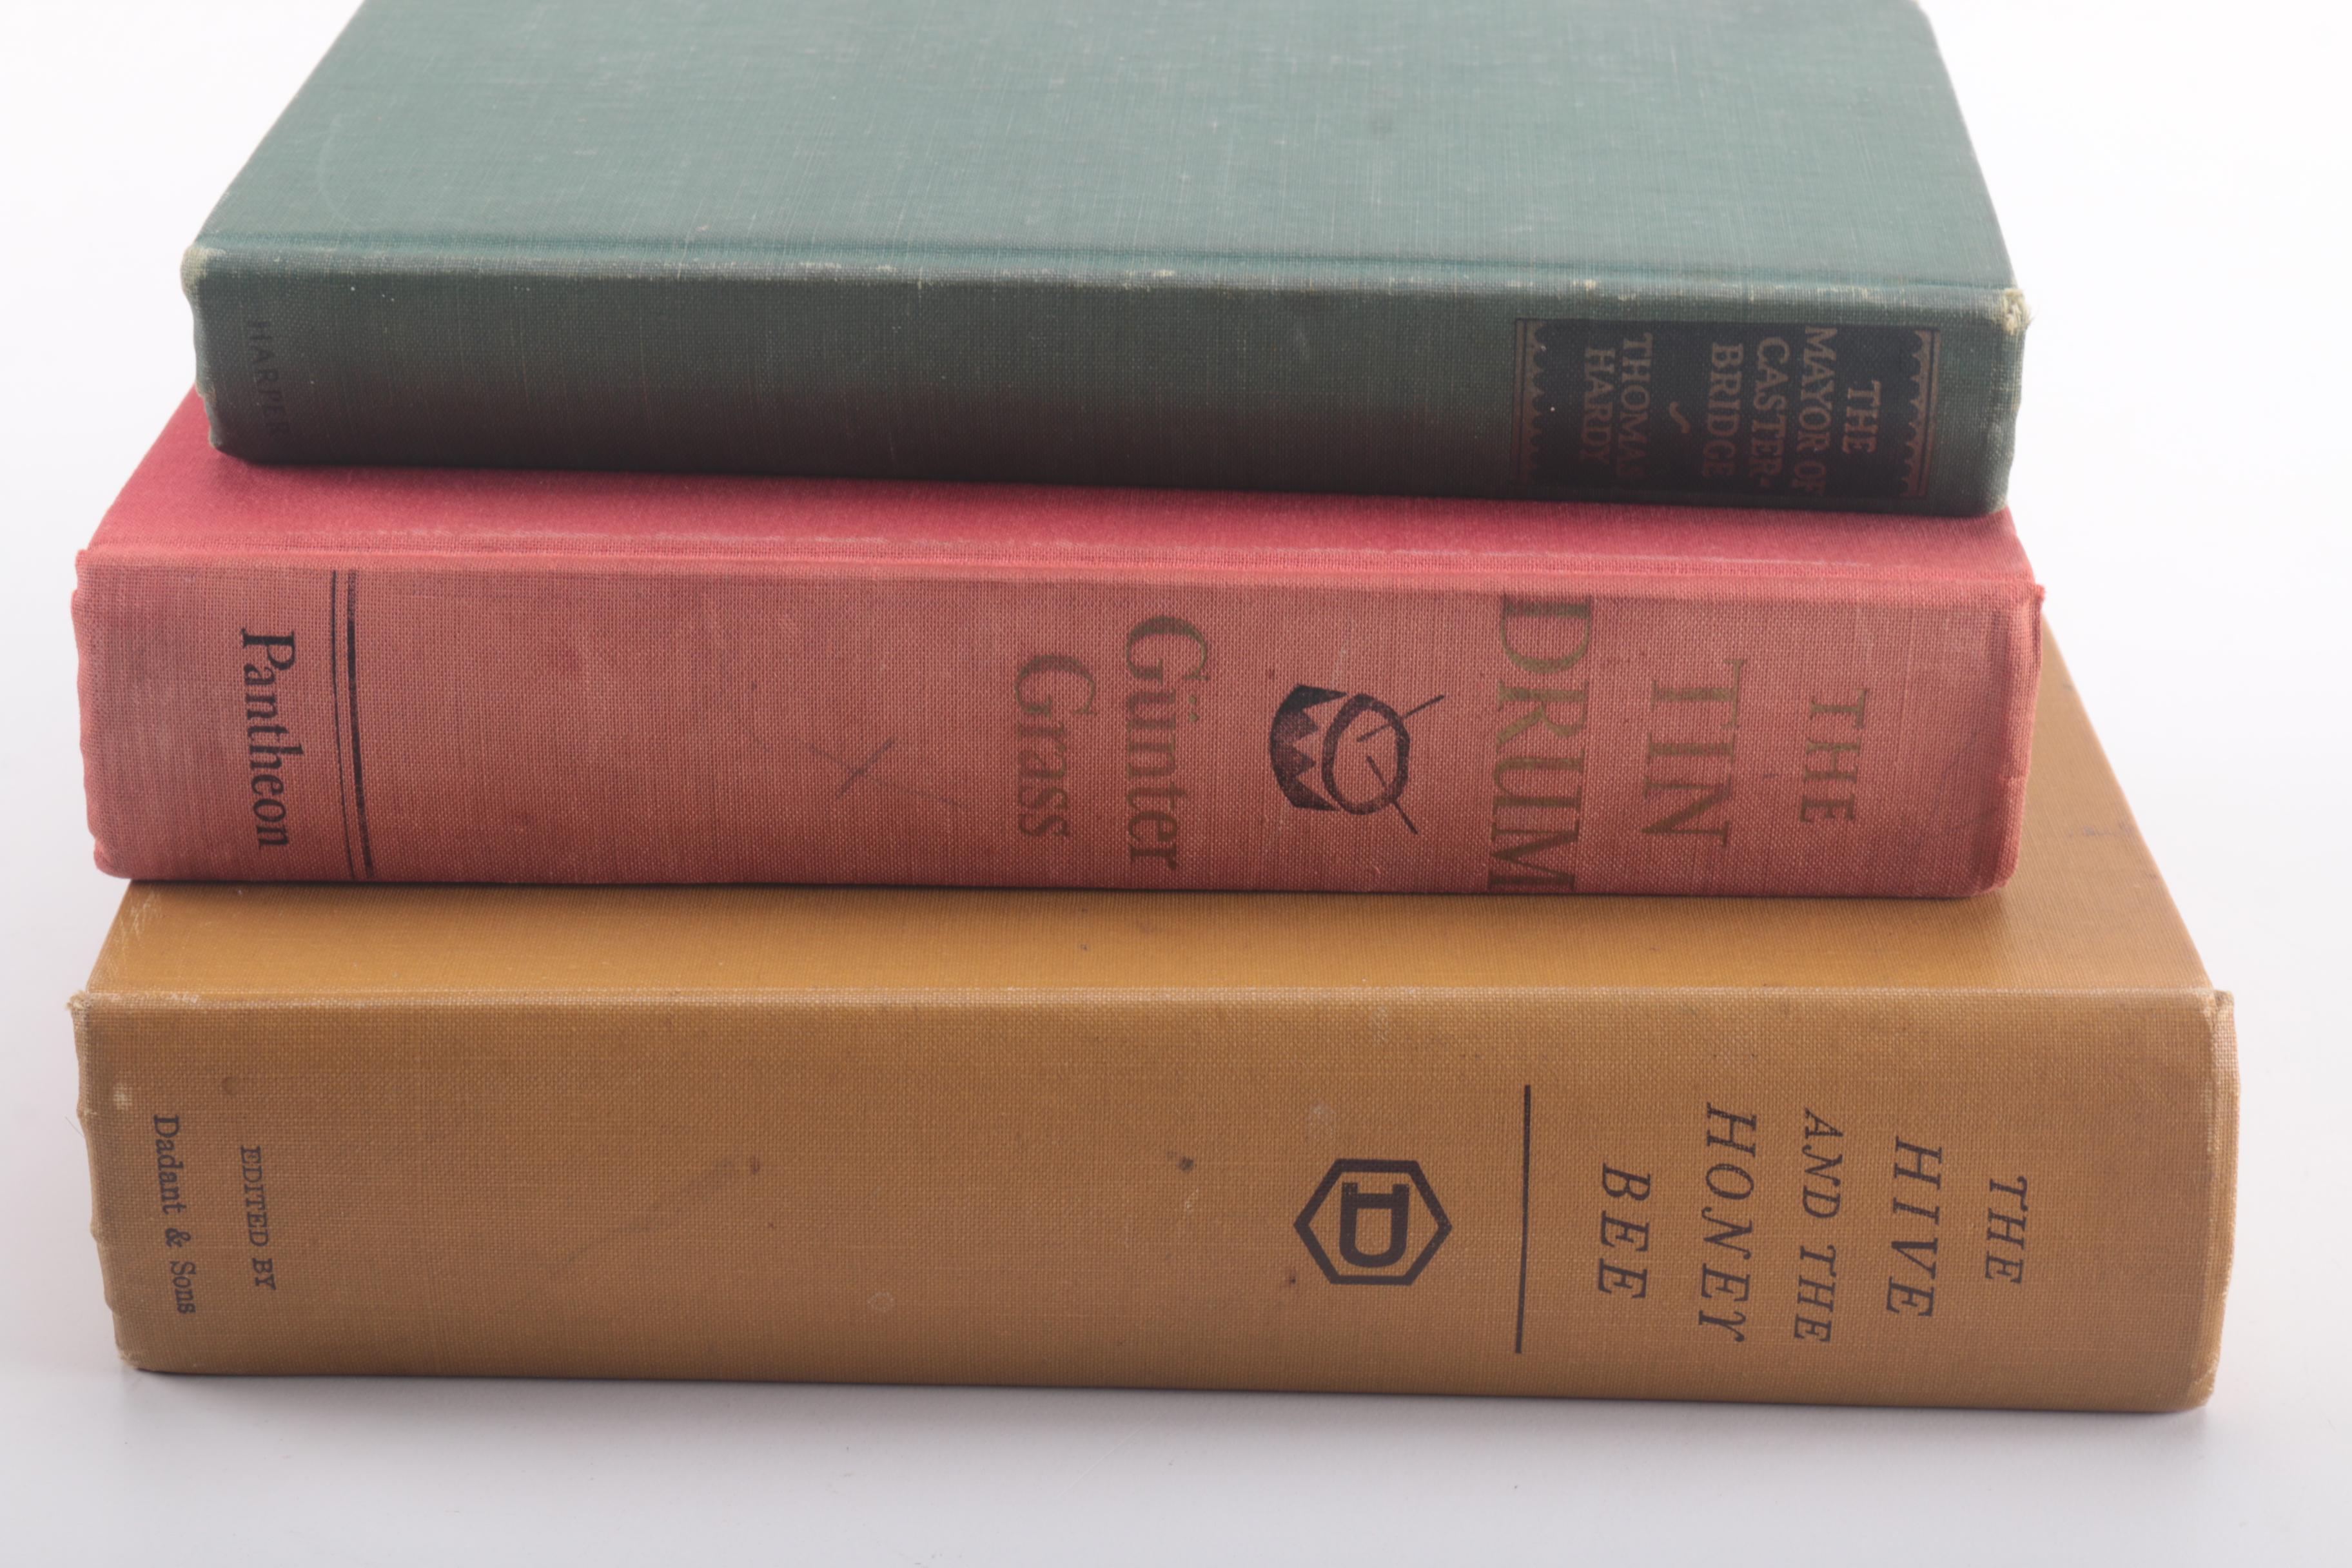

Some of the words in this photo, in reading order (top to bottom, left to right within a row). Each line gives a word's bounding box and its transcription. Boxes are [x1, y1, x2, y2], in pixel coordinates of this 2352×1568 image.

[1580, 347, 1616, 464] HARDY
[1616, 333, 1654, 479] THOMAS
[1701, 342, 1744, 478] BRIDGE
[1749, 336, 1791, 488] CASTER-
[1797, 326, 1838, 453] MAYOR
[1841, 380, 1881, 455] THE
[1791, 459, 1827, 496] OF
[240, 627, 304, 850] Pantheon
[1014, 654, 1098, 838] Grass
[1125, 615, 1210, 870] Günter
[1487, 595, 1592, 890] DRUM
[1641, 658, 1746, 848] TIN
[1799, 687, 1869, 823] THE
[153, 1114, 187, 1215] Dadant
[240, 1144, 269, 1247] EDITED
[1698, 1102, 1757, 1342] HONEY
[1801, 1108, 1843, 1219] AND
[1886, 1135, 1943, 1317] HIVE
[164, 1228, 191, 1248] &
[170, 1260, 196, 1314] Sons
[252, 1258, 276, 1290] BY
[1598, 1163, 1651, 1298] BEE
[1794, 1244, 1837, 1343] THE
[1985, 1176, 2028, 1284] THE
